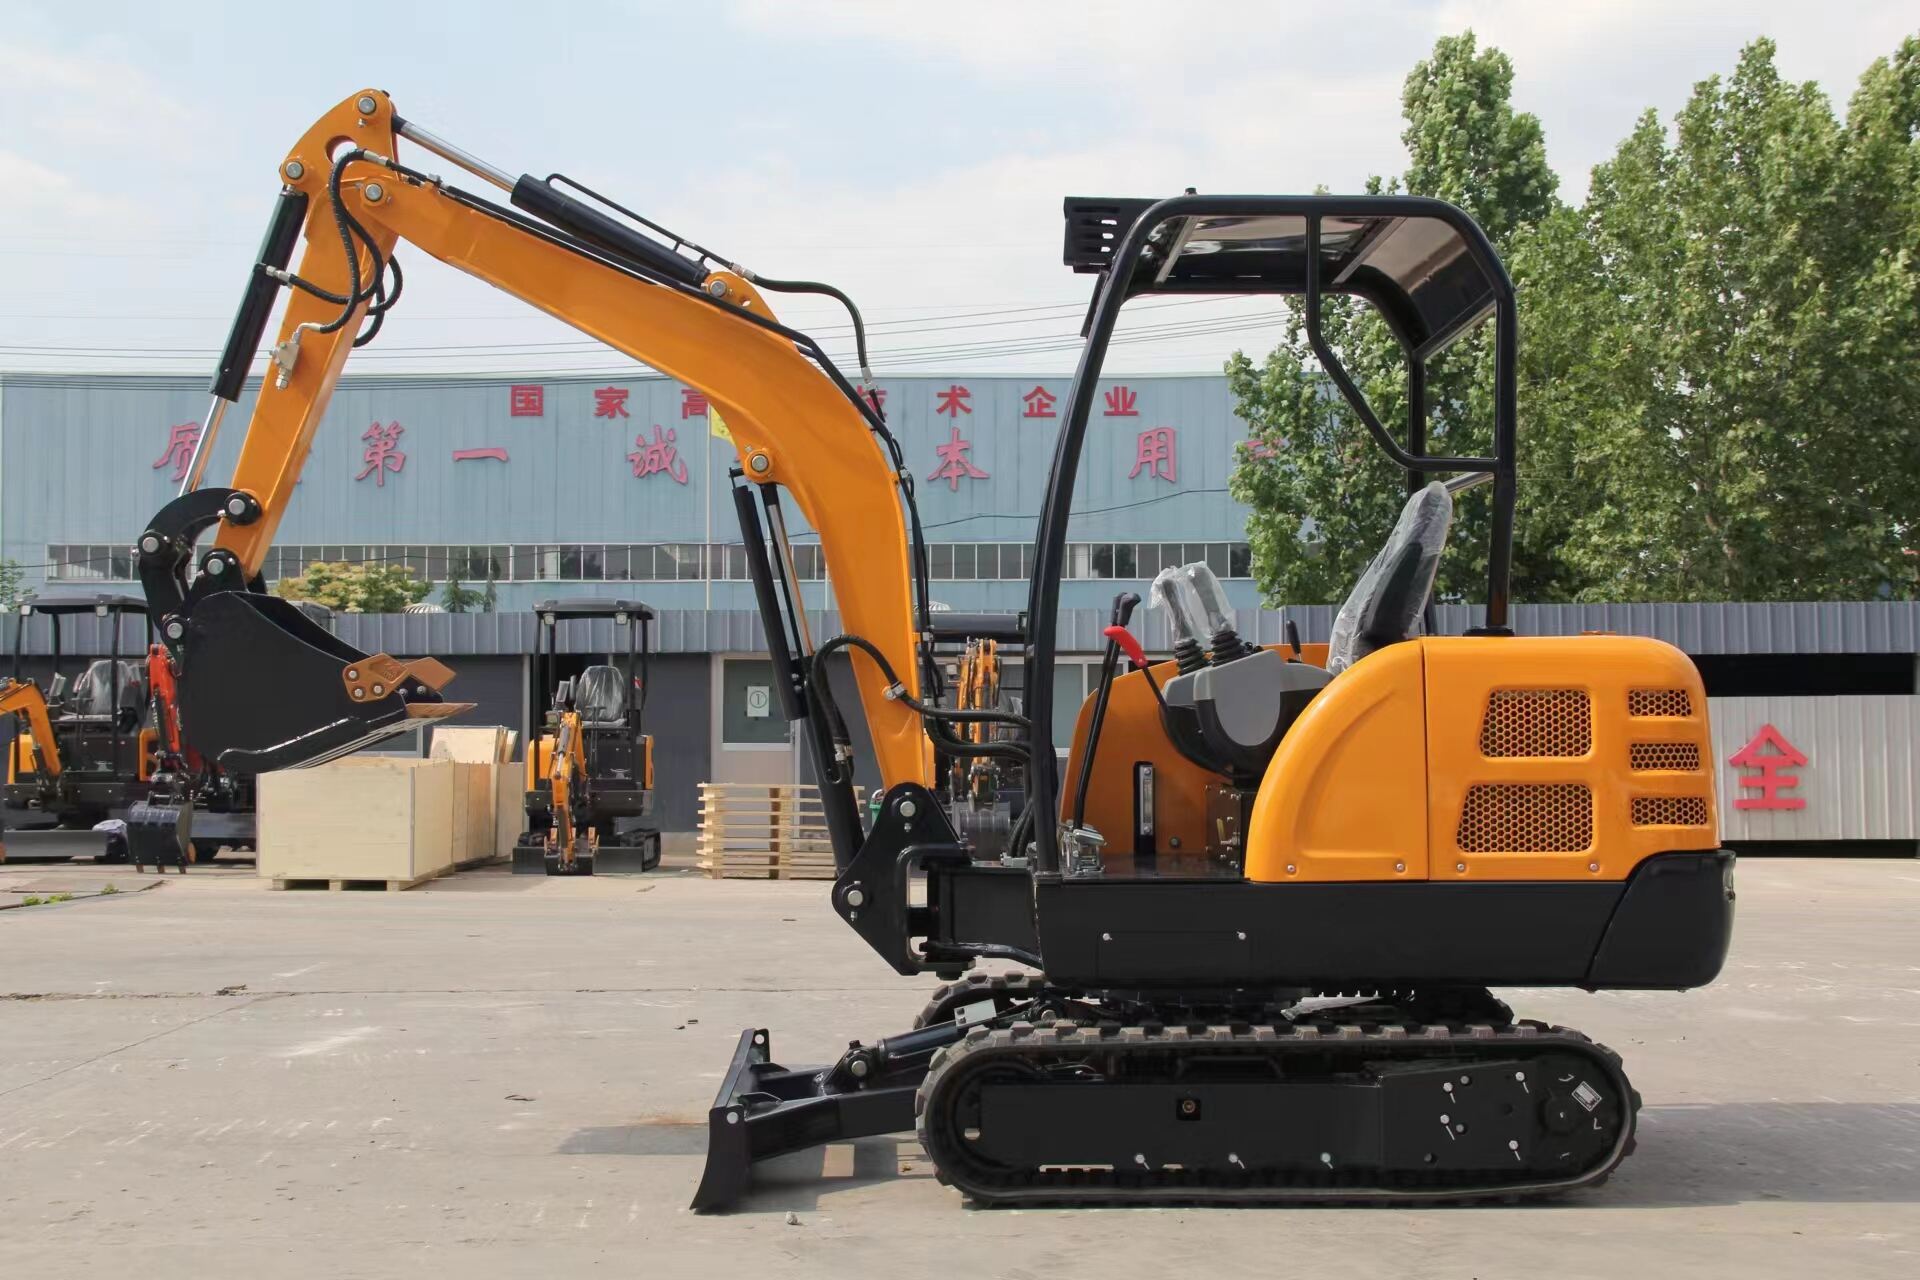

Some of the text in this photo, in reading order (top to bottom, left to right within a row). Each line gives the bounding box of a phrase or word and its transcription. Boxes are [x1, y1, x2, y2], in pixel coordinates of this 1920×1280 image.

[511, 384, 1138, 419] 国家高术企业
[152, 421, 509, 487] 质第一
[1728, 723, 1809, 811] 全
